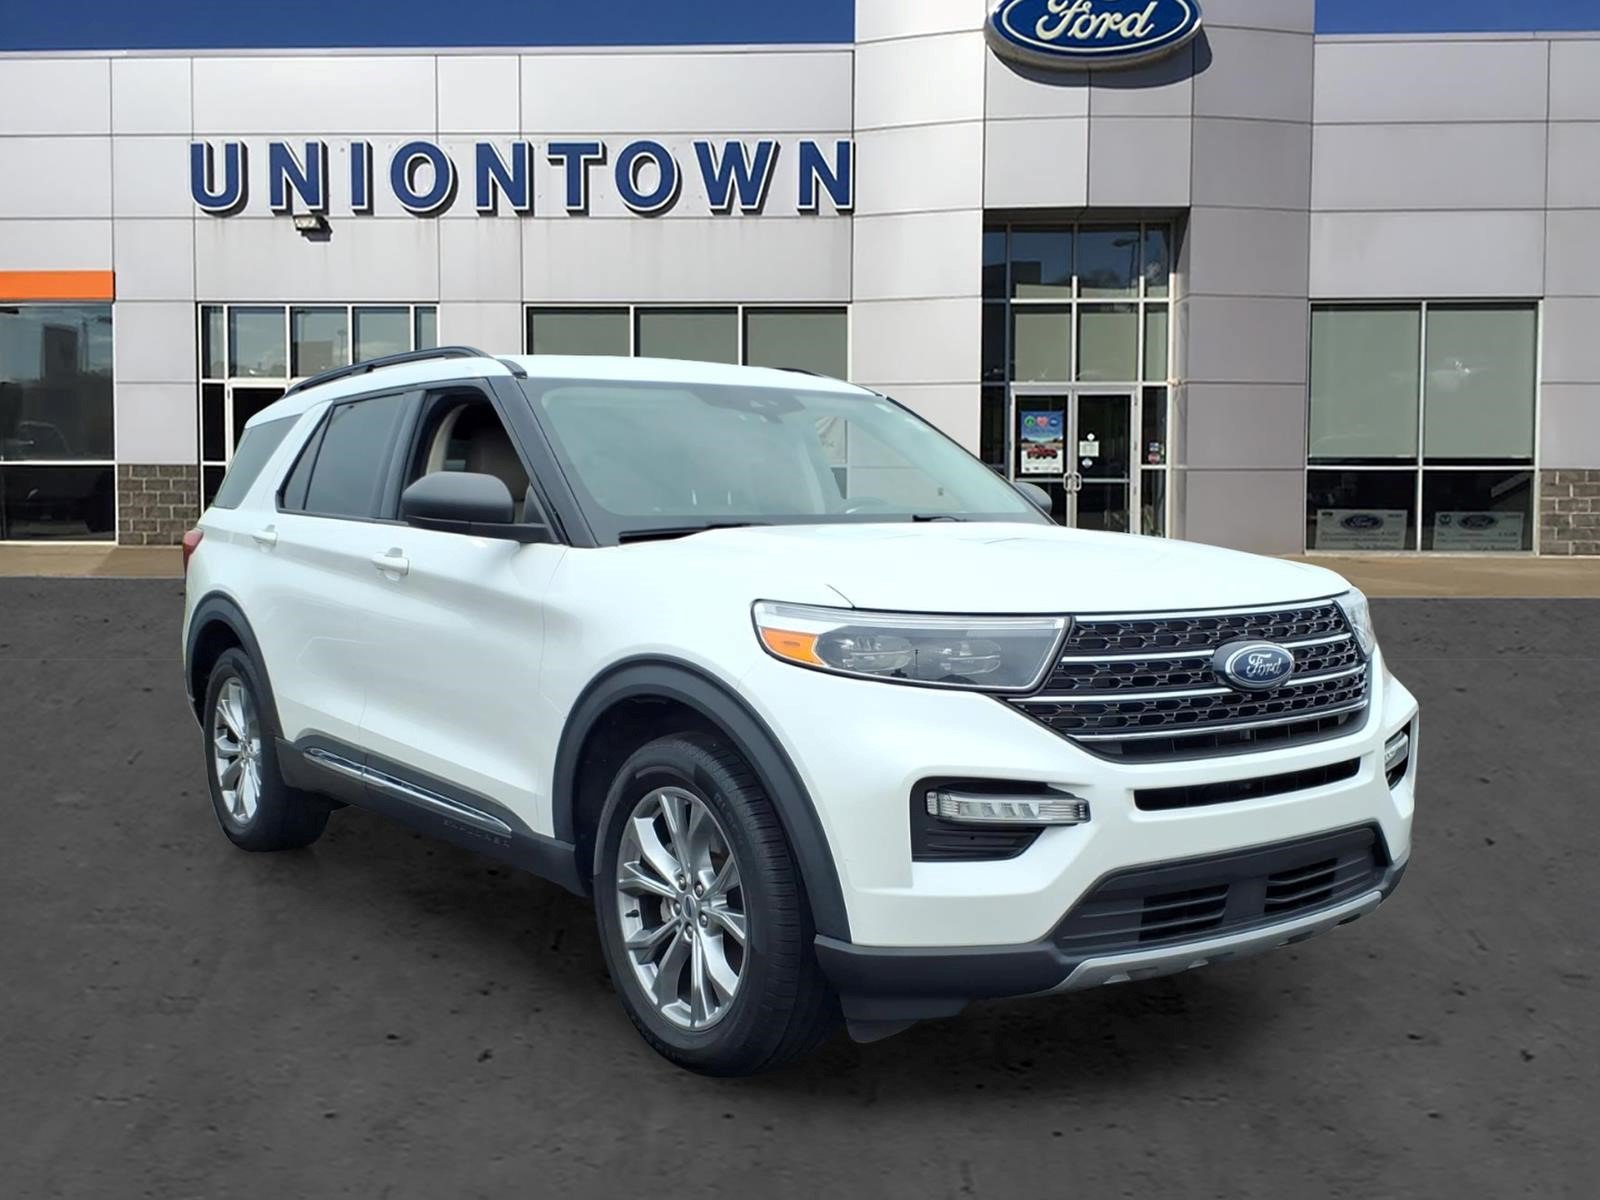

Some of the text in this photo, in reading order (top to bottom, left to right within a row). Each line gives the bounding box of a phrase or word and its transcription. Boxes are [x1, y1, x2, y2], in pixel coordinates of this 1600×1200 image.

[1036, 0, 1158, 40] Ford
[189, 139, 853, 214] UNIONTOWN
[1246, 653, 1282, 678] Ford
